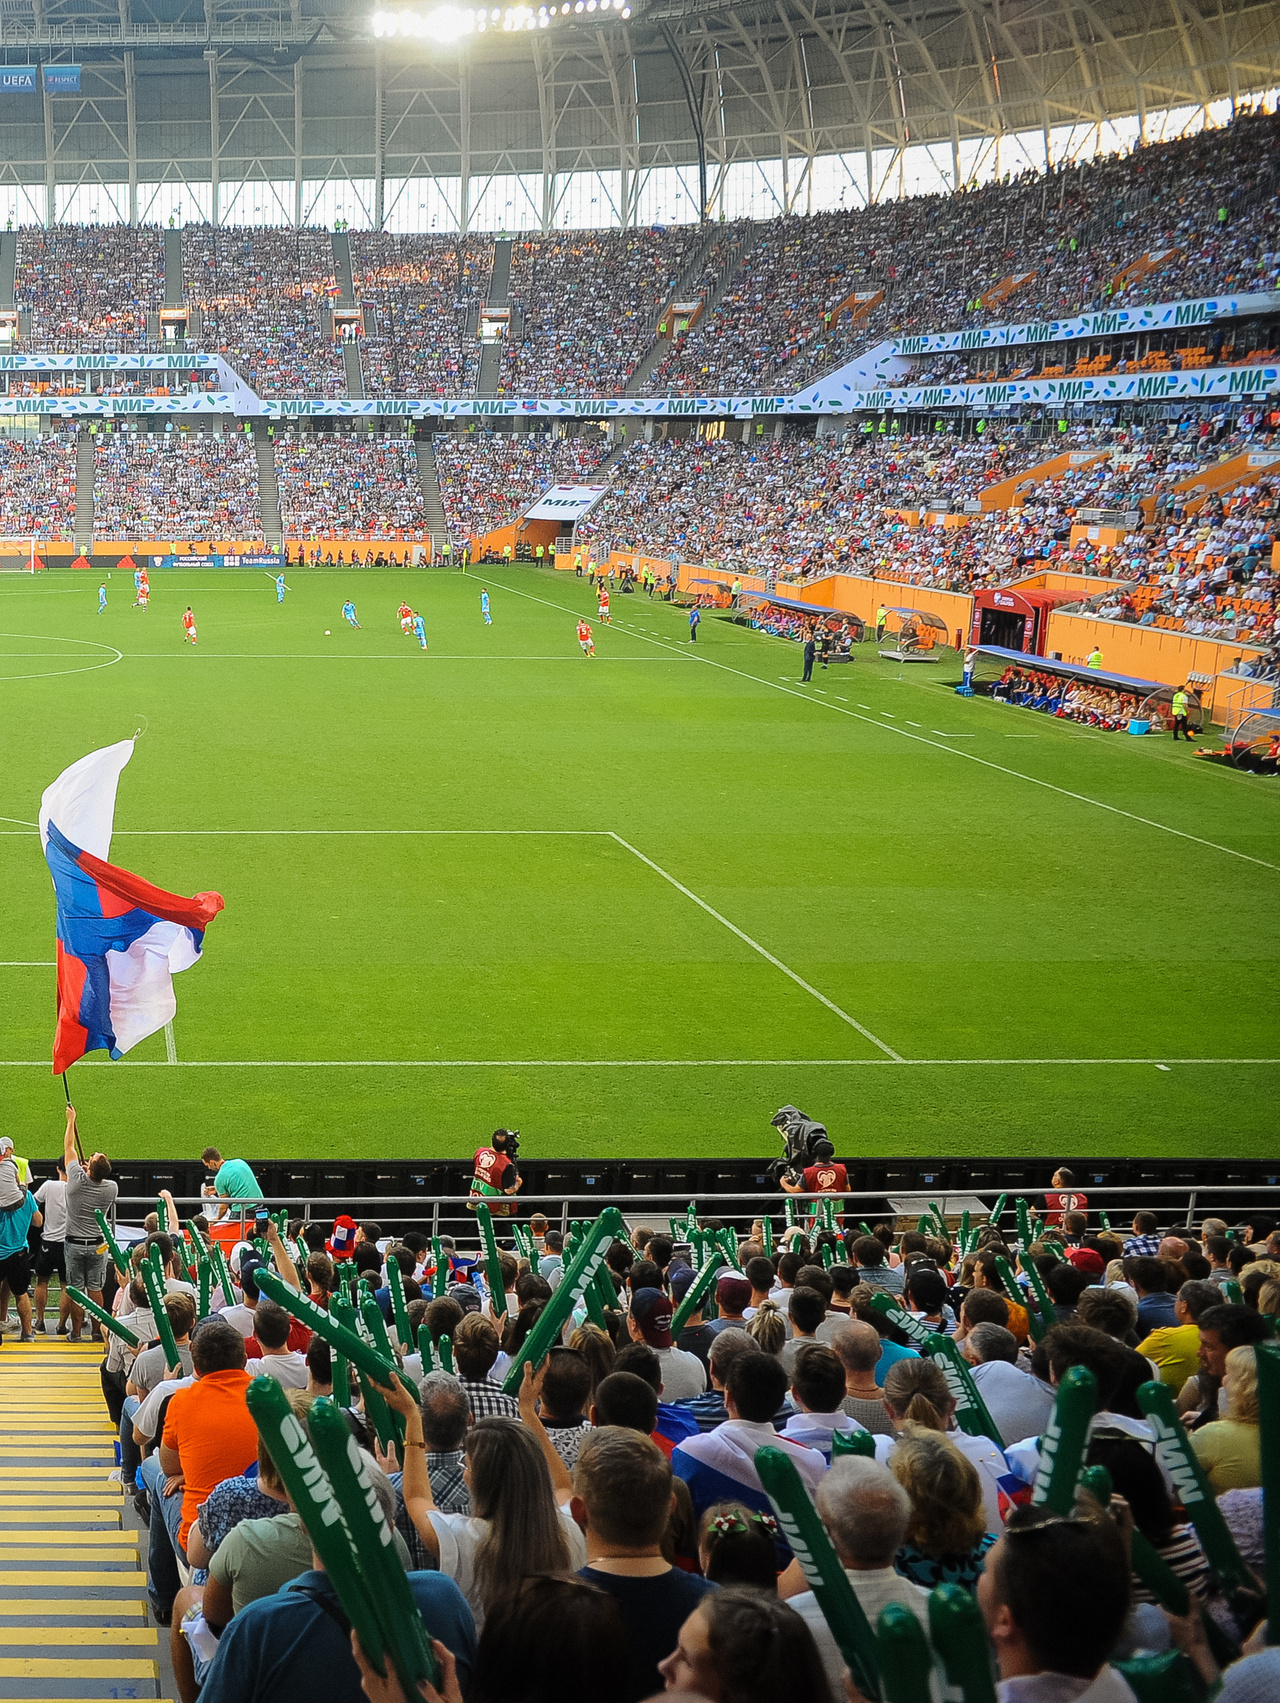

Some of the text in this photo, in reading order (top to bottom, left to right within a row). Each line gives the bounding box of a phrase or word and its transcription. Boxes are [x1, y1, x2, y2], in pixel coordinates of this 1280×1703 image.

[2, 75, 33, 86] UEFA
[1175, 301, 1218, 325] МИР
[1092, 312, 1129, 334] МИР
[961, 330, 990, 348] МИР
[1026, 322, 1059, 342] МИР
[902, 337, 929, 354] МИР
[76, 355, 118, 368] МИР
[167, 355, 210, 368] МИР
[1137, 375, 1178, 397] МИР
[1229, 368, 1277, 392] МИР
[922, 388, 951, 405] МИР
[985, 384, 1016, 403] МИР
[1058, 380, 1094, 400] МИР
[16, 400, 58, 412] МИР
[112, 399, 155, 411] МИР
[281, 401, 325, 414] МИР
[376, 401, 420, 414] МИР
[473, 401, 517, 414] МИР
[575, 401, 618, 414] МИР
[667, 400, 708, 413] МИР
[751, 398, 785, 413] МИР
[866, 391, 892, 407] МИР
[542, 498, 591, 507] МИР
[569, 1236, 614, 1301] МИР
[933, 1352, 972, 1411] МИР
[1147, 1413, 1205, 1504] МИР
[279, 1413, 342, 1528] МИР
